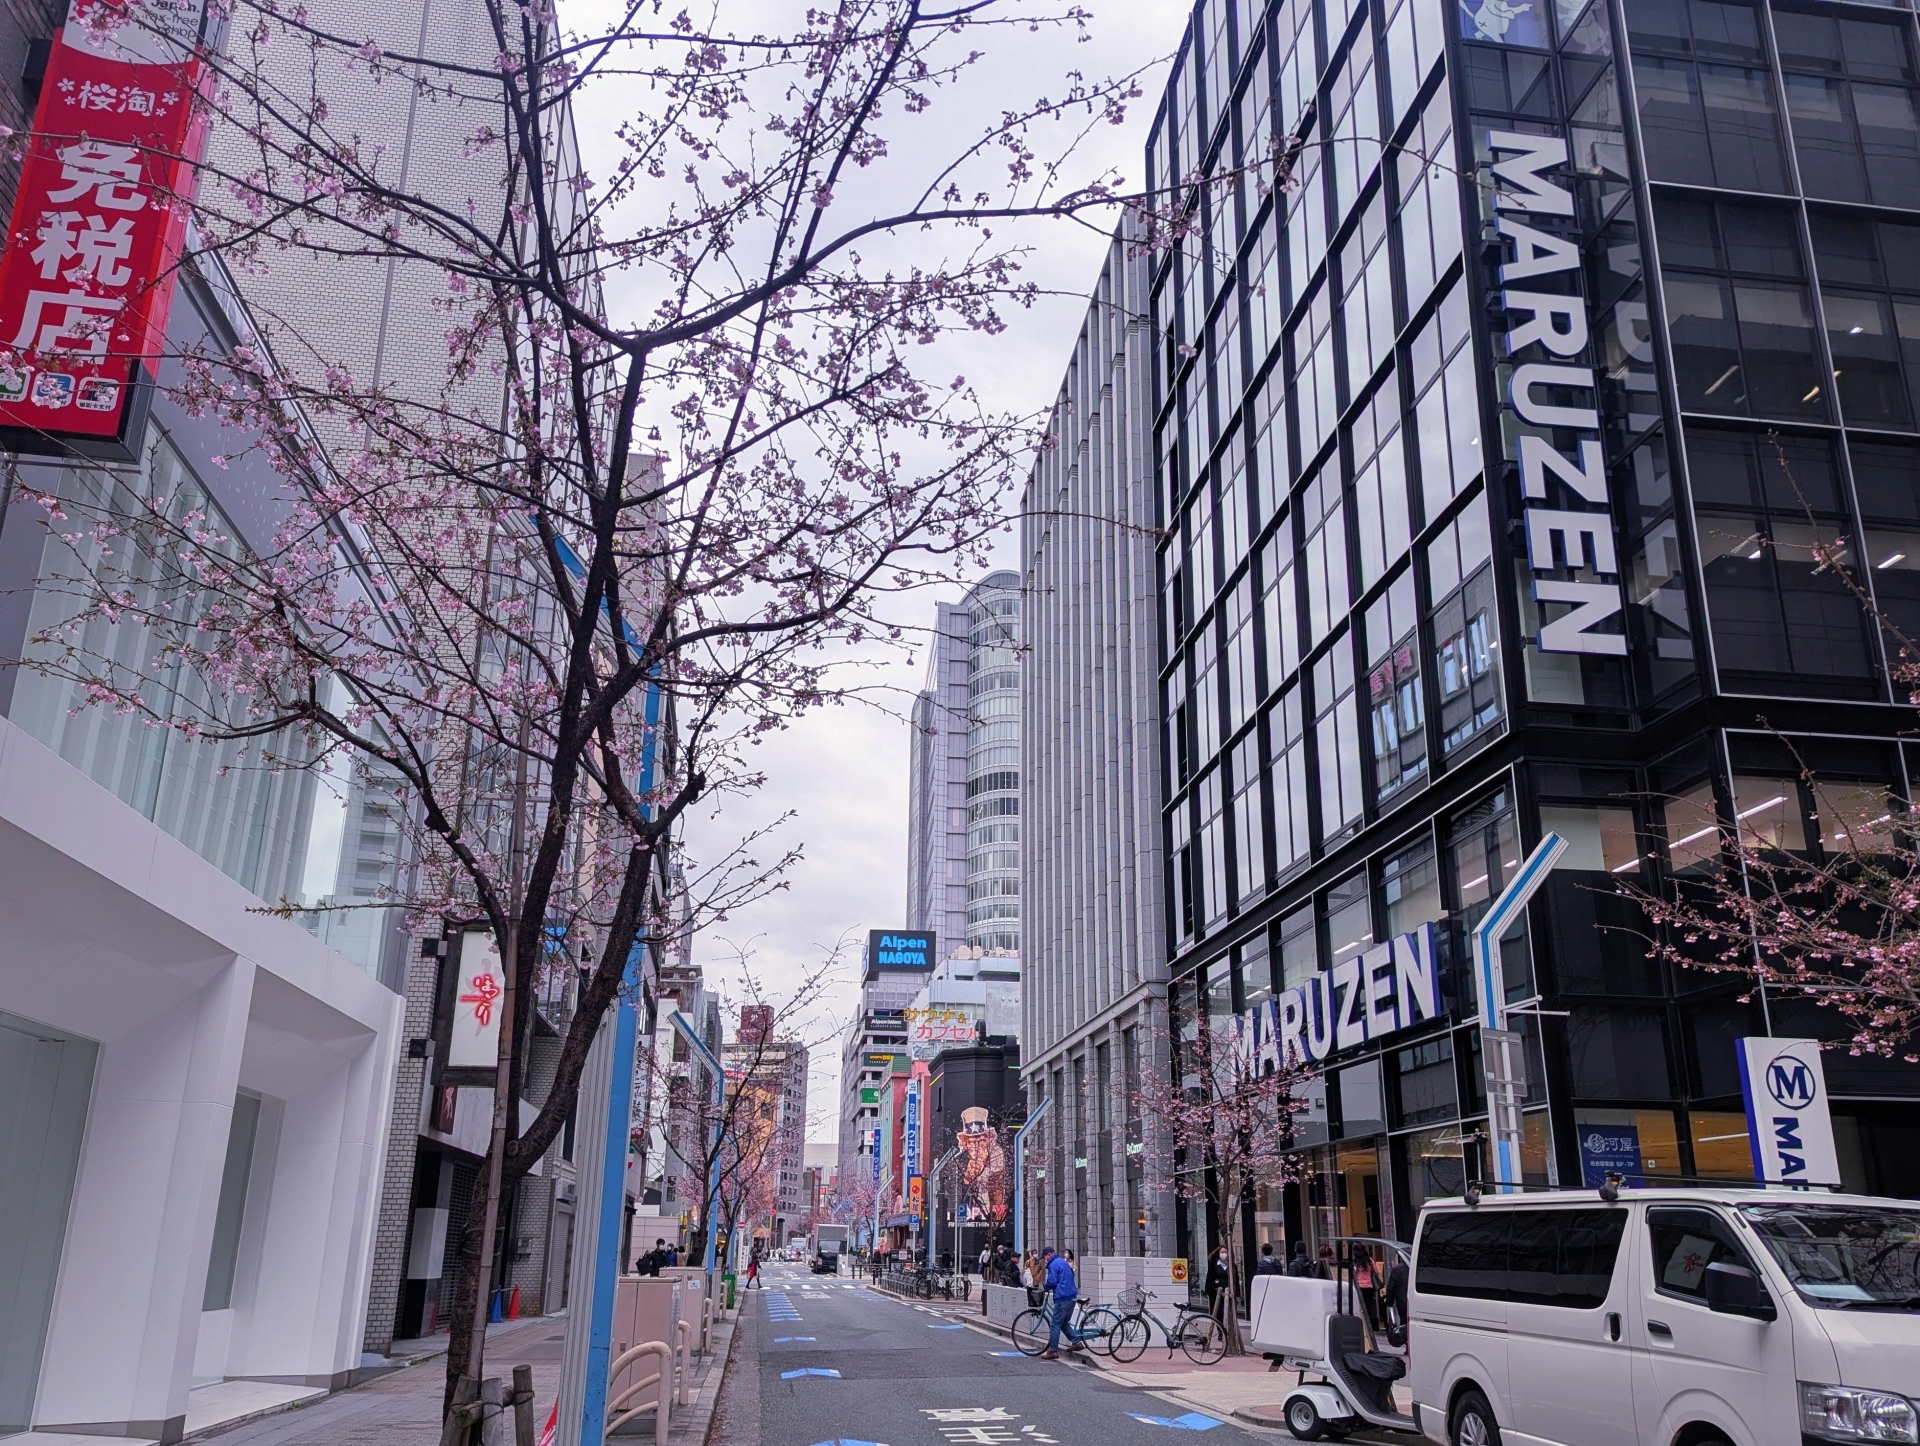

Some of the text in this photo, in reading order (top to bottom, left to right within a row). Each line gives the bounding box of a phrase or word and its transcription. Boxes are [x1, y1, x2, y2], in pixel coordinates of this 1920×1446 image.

[11, 141, 148, 365] 免税店
[1487, 129, 1628, 656] MARUZEN
[880, 935, 927, 951] Alpen
[878, 951, 927, 965] NAGOYA
[1229, 921, 1440, 1081] MARUZEN
[903, 1008, 956, 1024] サウナ
[957, 1013, 967, 1024] &
[1769, 1062, 1812, 1101] M
[911, 1214, 918, 1223] P
[958, 1205, 966, 1216] P
